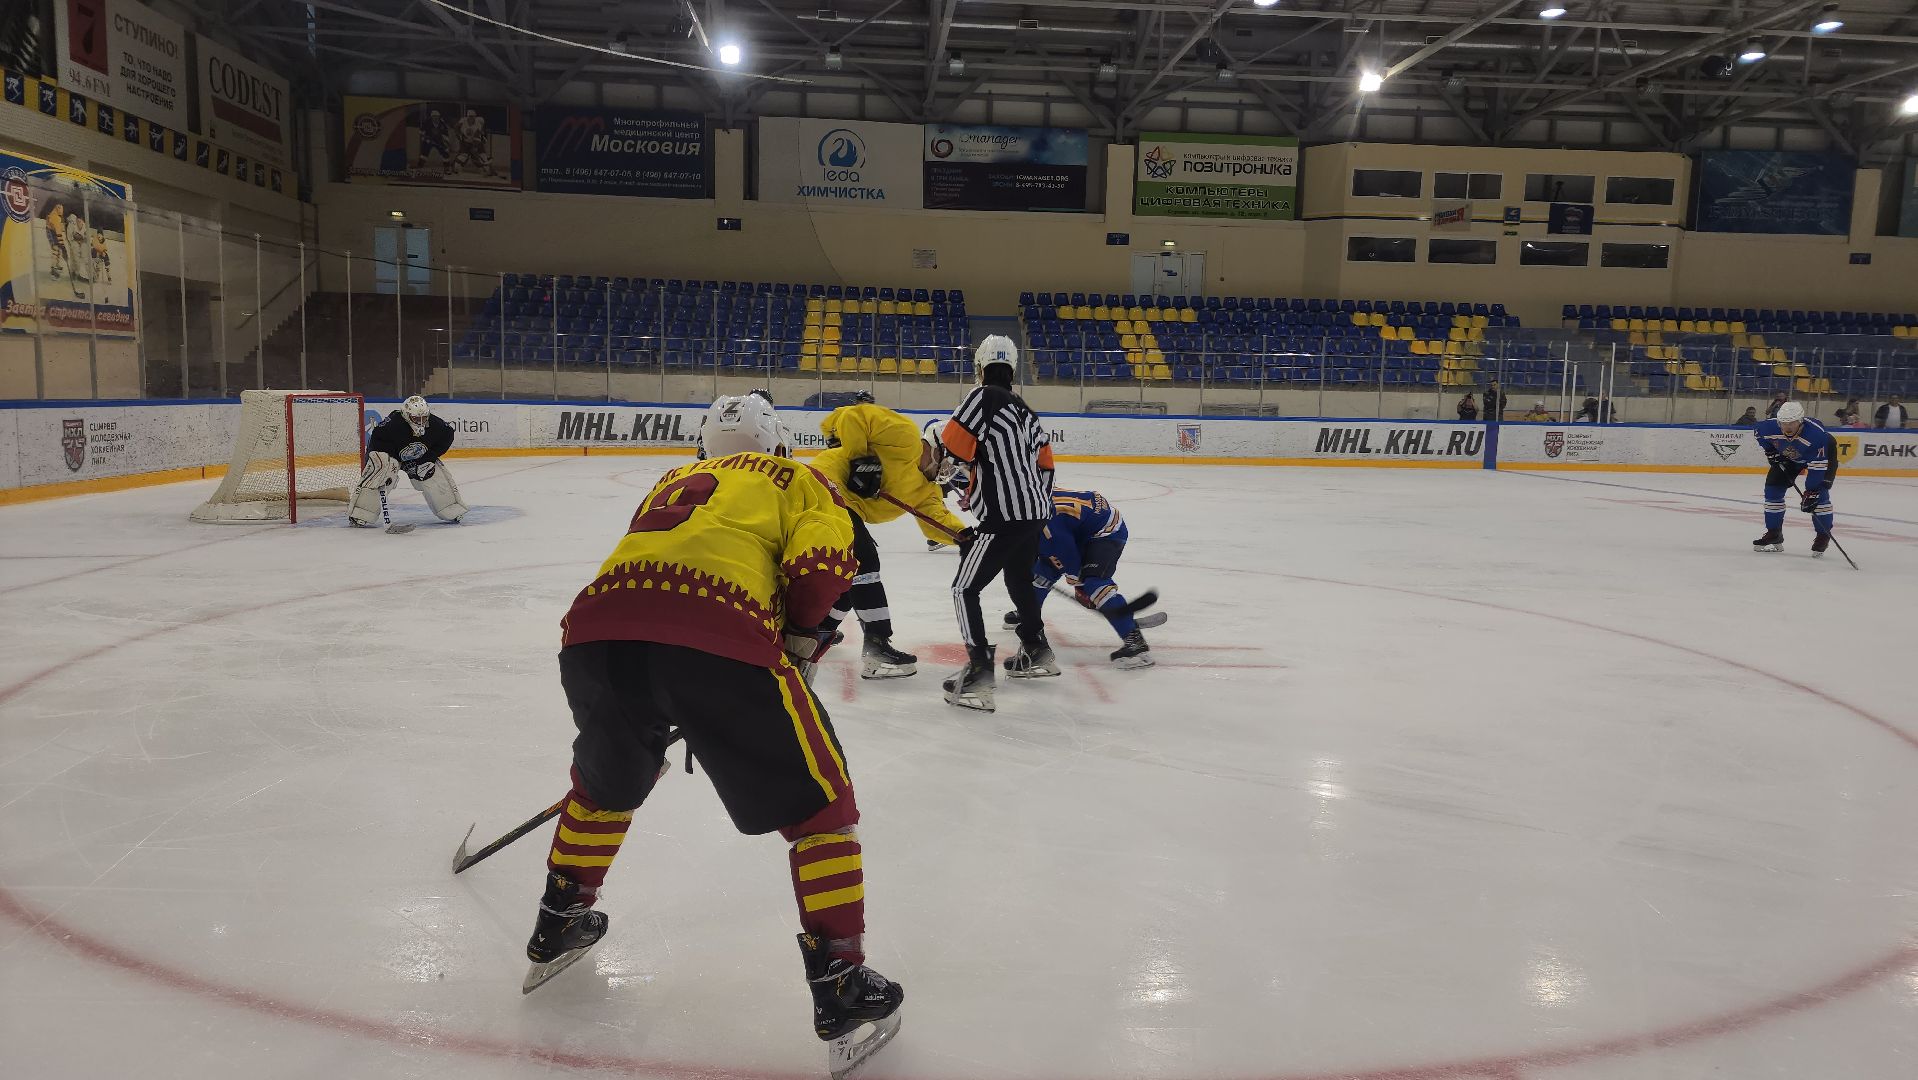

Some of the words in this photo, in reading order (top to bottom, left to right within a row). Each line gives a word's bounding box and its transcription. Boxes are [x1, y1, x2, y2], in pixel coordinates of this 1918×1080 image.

[114, 14, 178, 59] СТУПИНО!
[137, 59, 151, 73] ЧТО
[153, 66, 172, 82] НАДО
[93, 77, 110, 97] FM
[120, 66, 136, 80] ДЛЯ
[137, 72, 176, 97] ХОРОШЕГО
[209, 56, 282, 121] CODEST
[126, 83, 174, 110] НАСТРОЕНИЯ
[613, 117, 699, 129] Многопрофильный
[590, 133, 701, 156] Московия
[613, 128, 672, 137] медицинский
[674, 131, 700, 140] центр
[823, 168, 860, 182] leda
[797, 185, 885, 200] ХИМЧИСТКА
[1166, 185, 1268, 198] КОМПЬЮТЕРЫ
[1140, 197, 1221, 209] ЦИФРОВАЯ
[1224, 199, 1291, 210] ТЕХНИКА
[556, 411, 707, 442] MHL.KHL.
[1315, 427, 1485, 456] MHL.KHL.RU
[1863, 443, 1918, 457] БАНК
